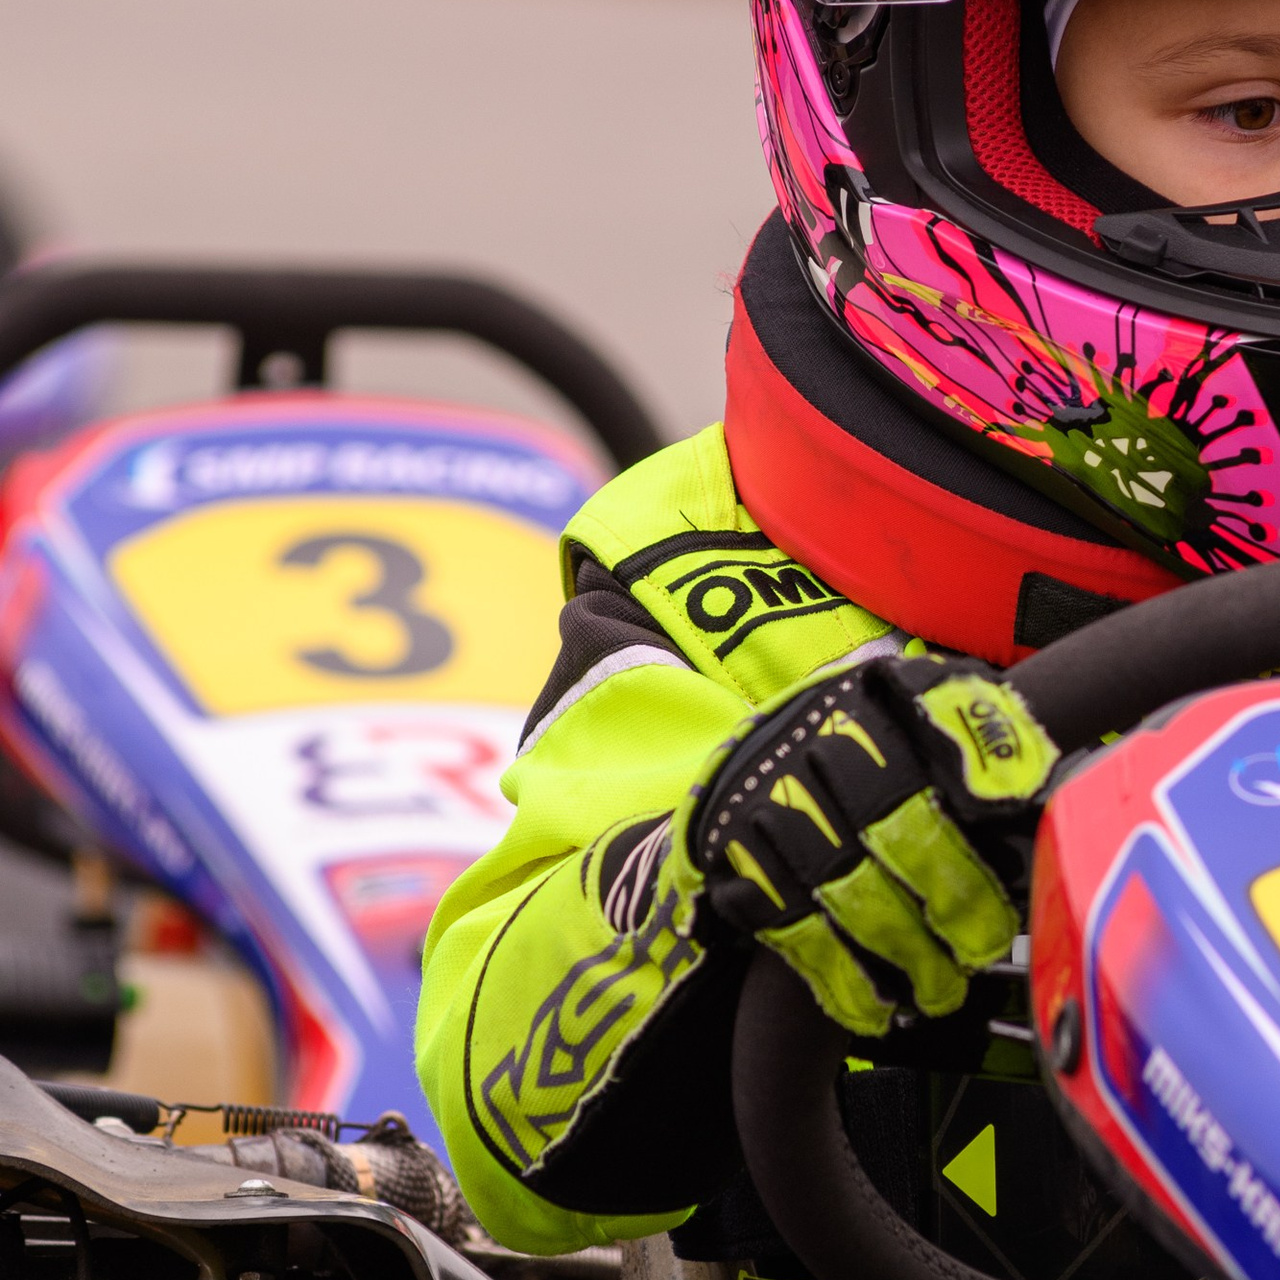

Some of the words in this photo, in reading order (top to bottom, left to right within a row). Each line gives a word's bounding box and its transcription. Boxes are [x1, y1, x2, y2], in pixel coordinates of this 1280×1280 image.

[277, 534, 453, 677] 3
[686, 567, 850, 633] OM
[969, 699, 1014, 760] OMP
